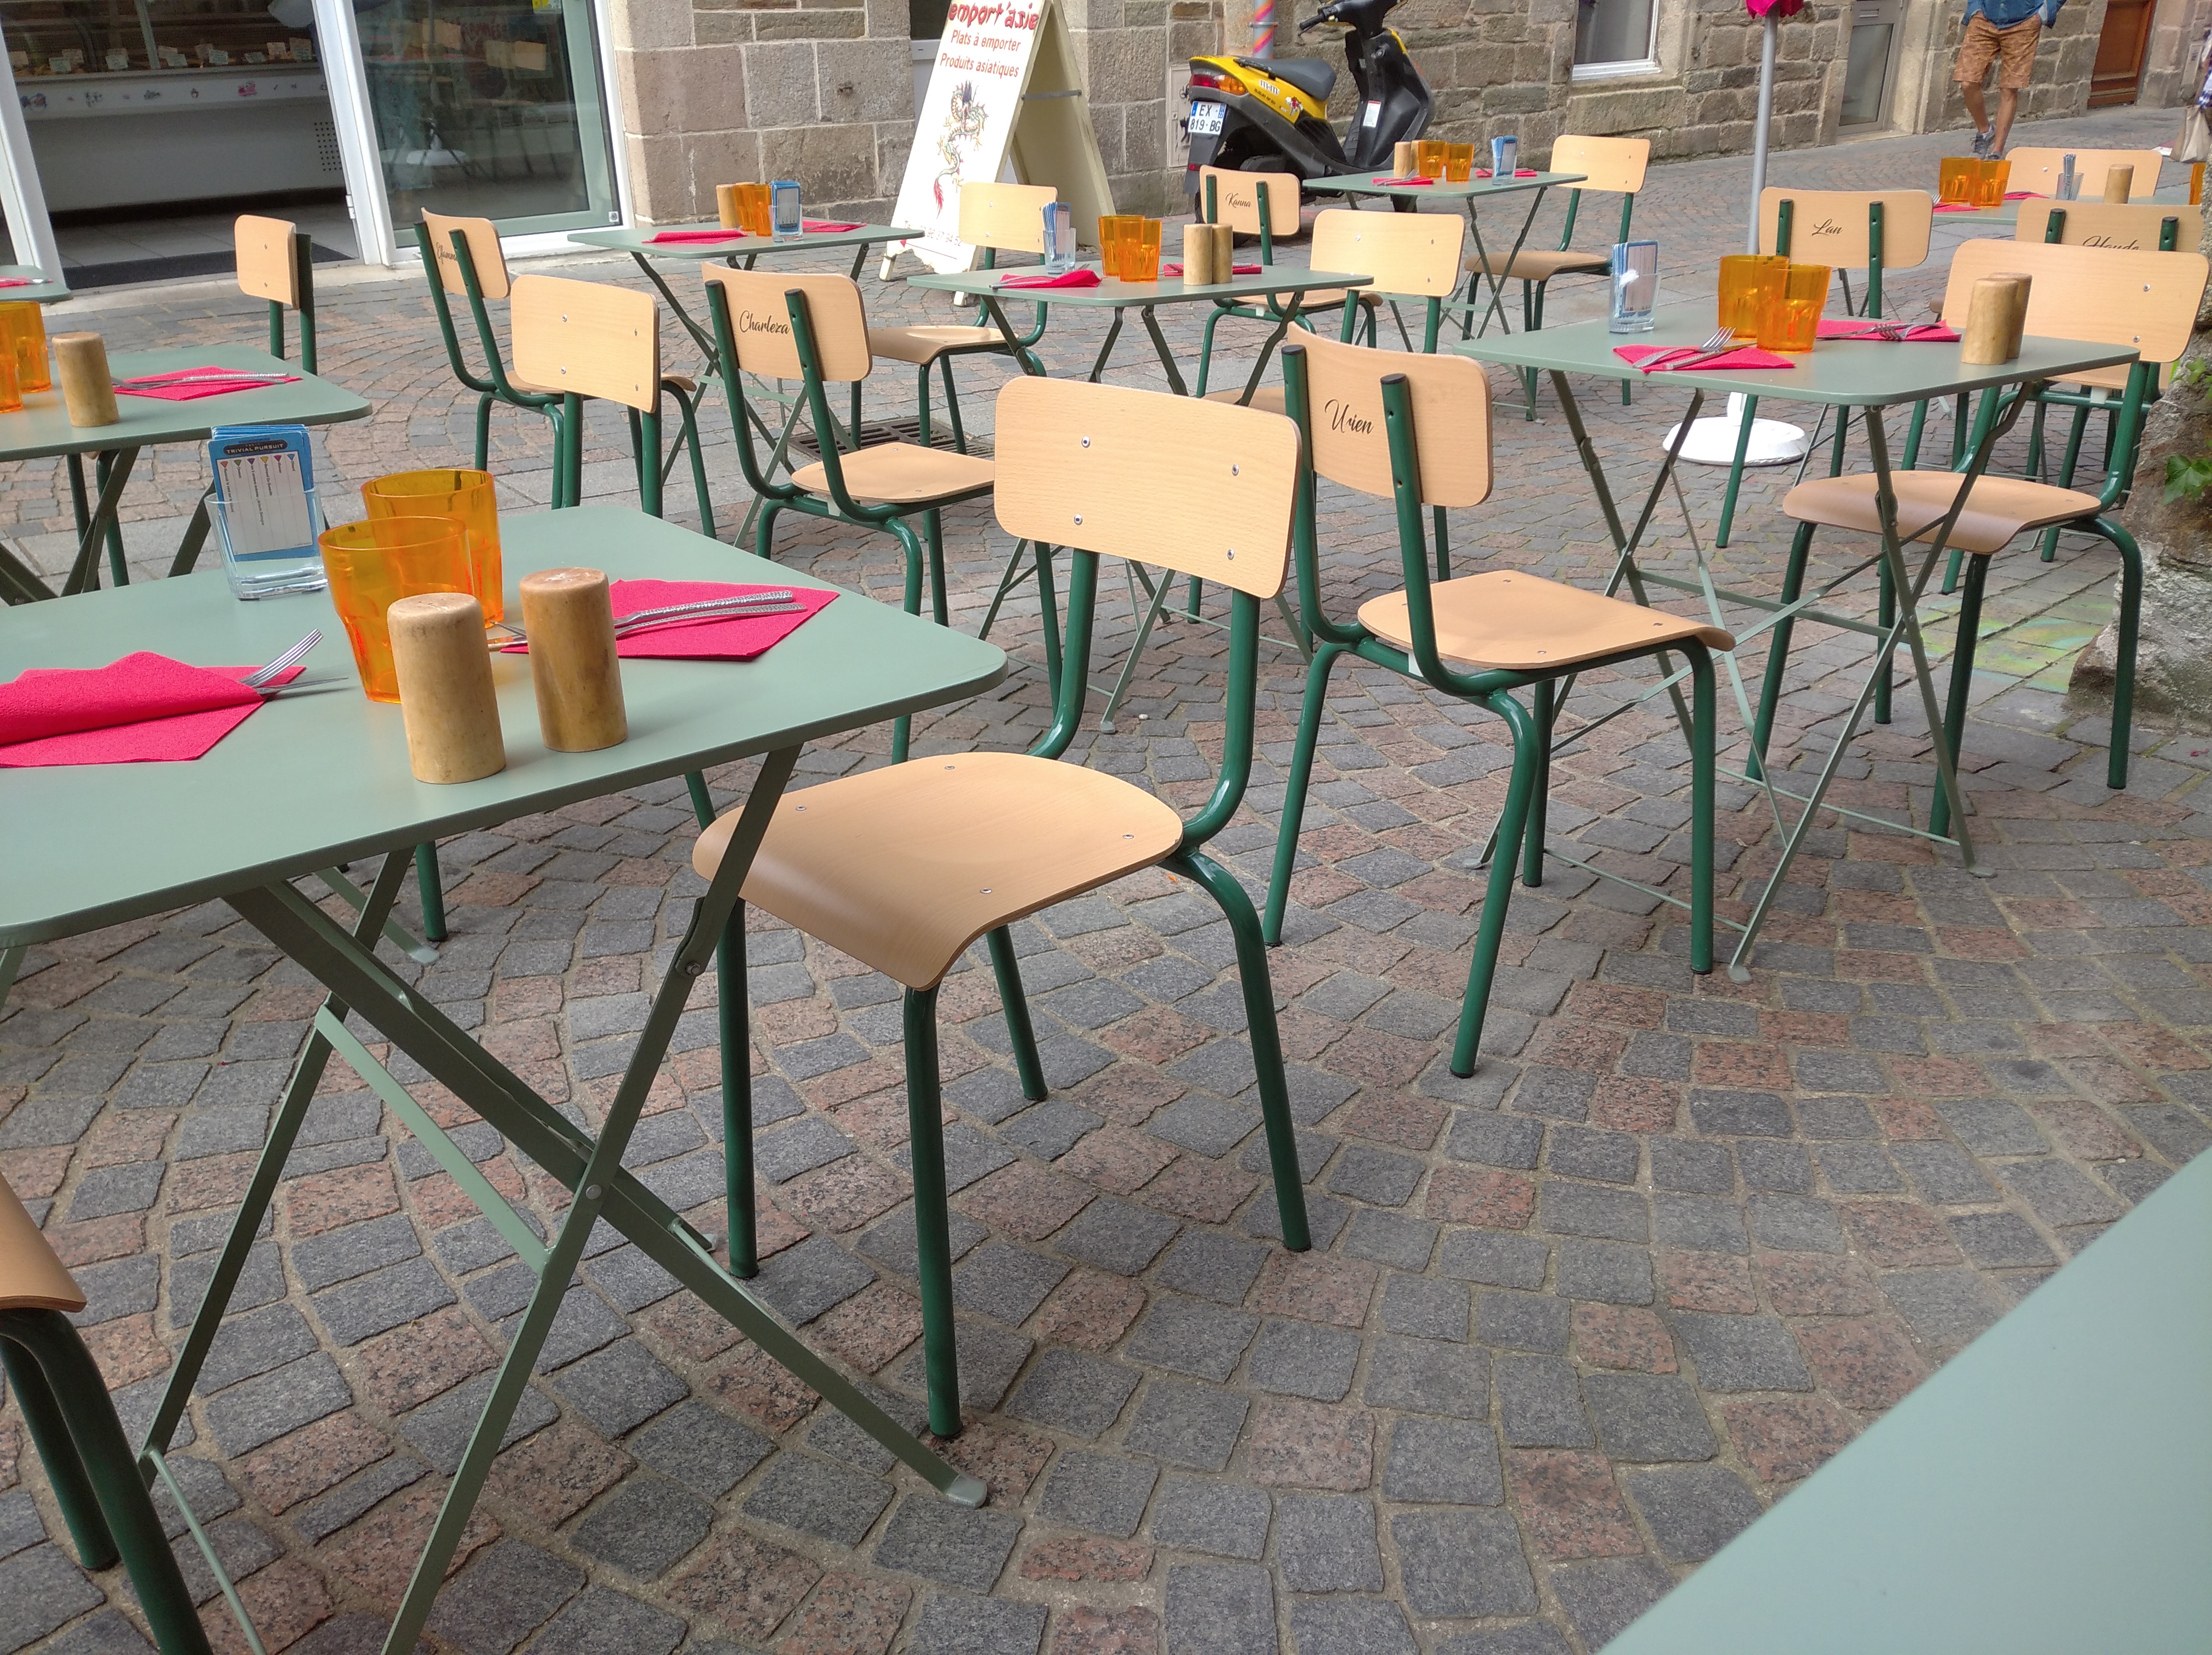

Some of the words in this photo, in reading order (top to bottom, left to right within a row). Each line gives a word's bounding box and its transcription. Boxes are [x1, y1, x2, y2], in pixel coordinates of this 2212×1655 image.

[951, 29, 972, 45] Plats
[973, 32, 979, 46] à
[981, 37, 1021, 52] emporter
[940, 53, 974, 70] Produits
[976, 59, 1019, 79] asiatiques
[1199, 105, 1212, 116] EX
[1190, 118, 1205, 131] 819
[1209, 120, 1221, 132] BG
[1812, 218, 1843, 236] Lan
[740, 310, 790, 335] Charleza
[1324, 399, 1374, 434] Urien
